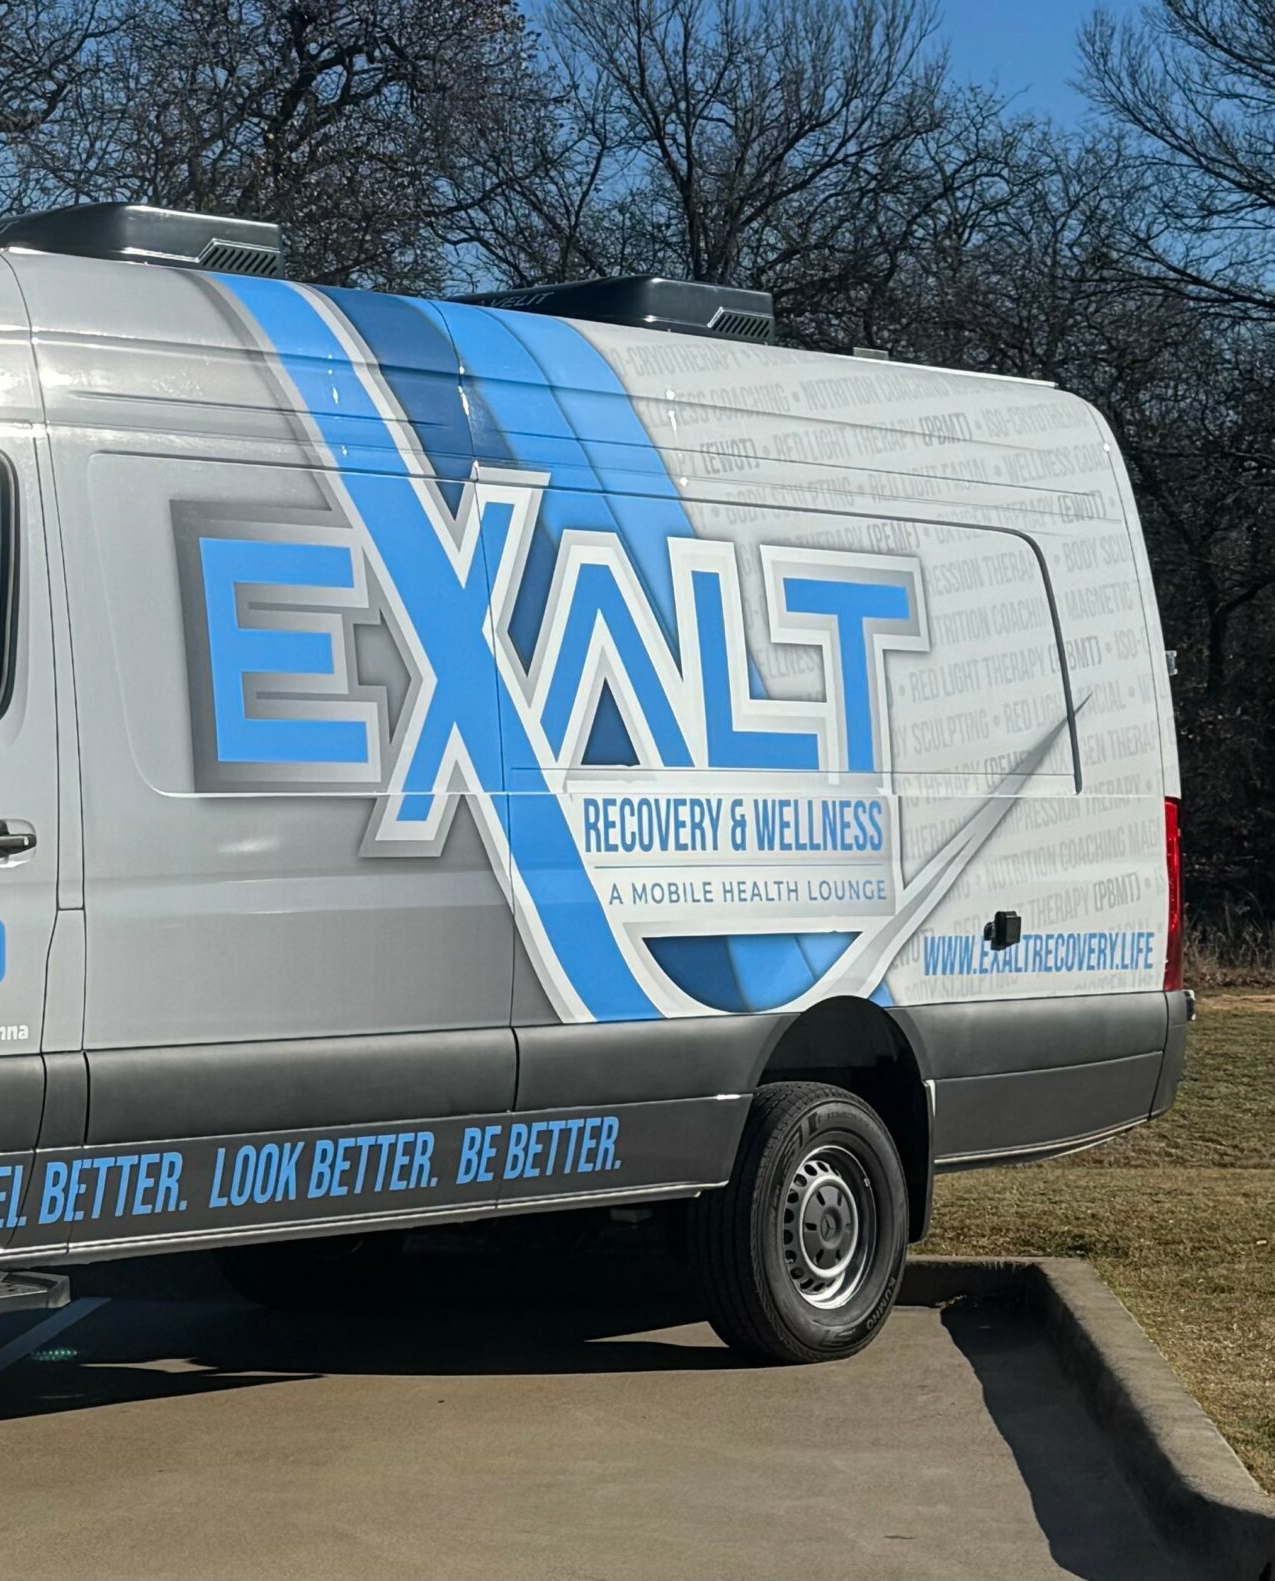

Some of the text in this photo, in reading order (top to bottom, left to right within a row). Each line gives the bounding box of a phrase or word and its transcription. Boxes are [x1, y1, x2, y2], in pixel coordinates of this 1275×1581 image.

[773, 431, 805, 460] RED
[803, 426, 851, 462] LIGHT
[853, 417, 919, 456] THERAPY
[918, 411, 973, 447] (PBMT)
[1002, 447, 1076, 483] WELLNESS
[1062, 536, 1099, 573] BODY
[197, 480, 915, 880] EXALT
[908, 667, 940, 703] RED
[940, 658, 982, 697] LIGHT
[982, 646, 1045, 688] THERAPY
[911, 707, 990, 755] SCULPTING
[1003, 699, 1033, 735] RED
[583, 797, 884, 853] RECOVERY & WELLNESS
[985, 843, 1059, 893] NUTRITION
[1058, 826, 1127, 871] COACHING
[608, 878, 888, 905] A MOBILE HEALTH LOUNGE
[1027, 883, 1091, 931] THERAPY
[1092, 871, 1142, 912] (PBMT)
[38, 1151, 188, 1225] BETTER.
[209, 1140, 305, 1209] LOOK
[307, 1130, 439, 1200] BETTER.
[456, 1124, 502, 1185] BE
[502, 1115, 622, 1181] BETTER.
